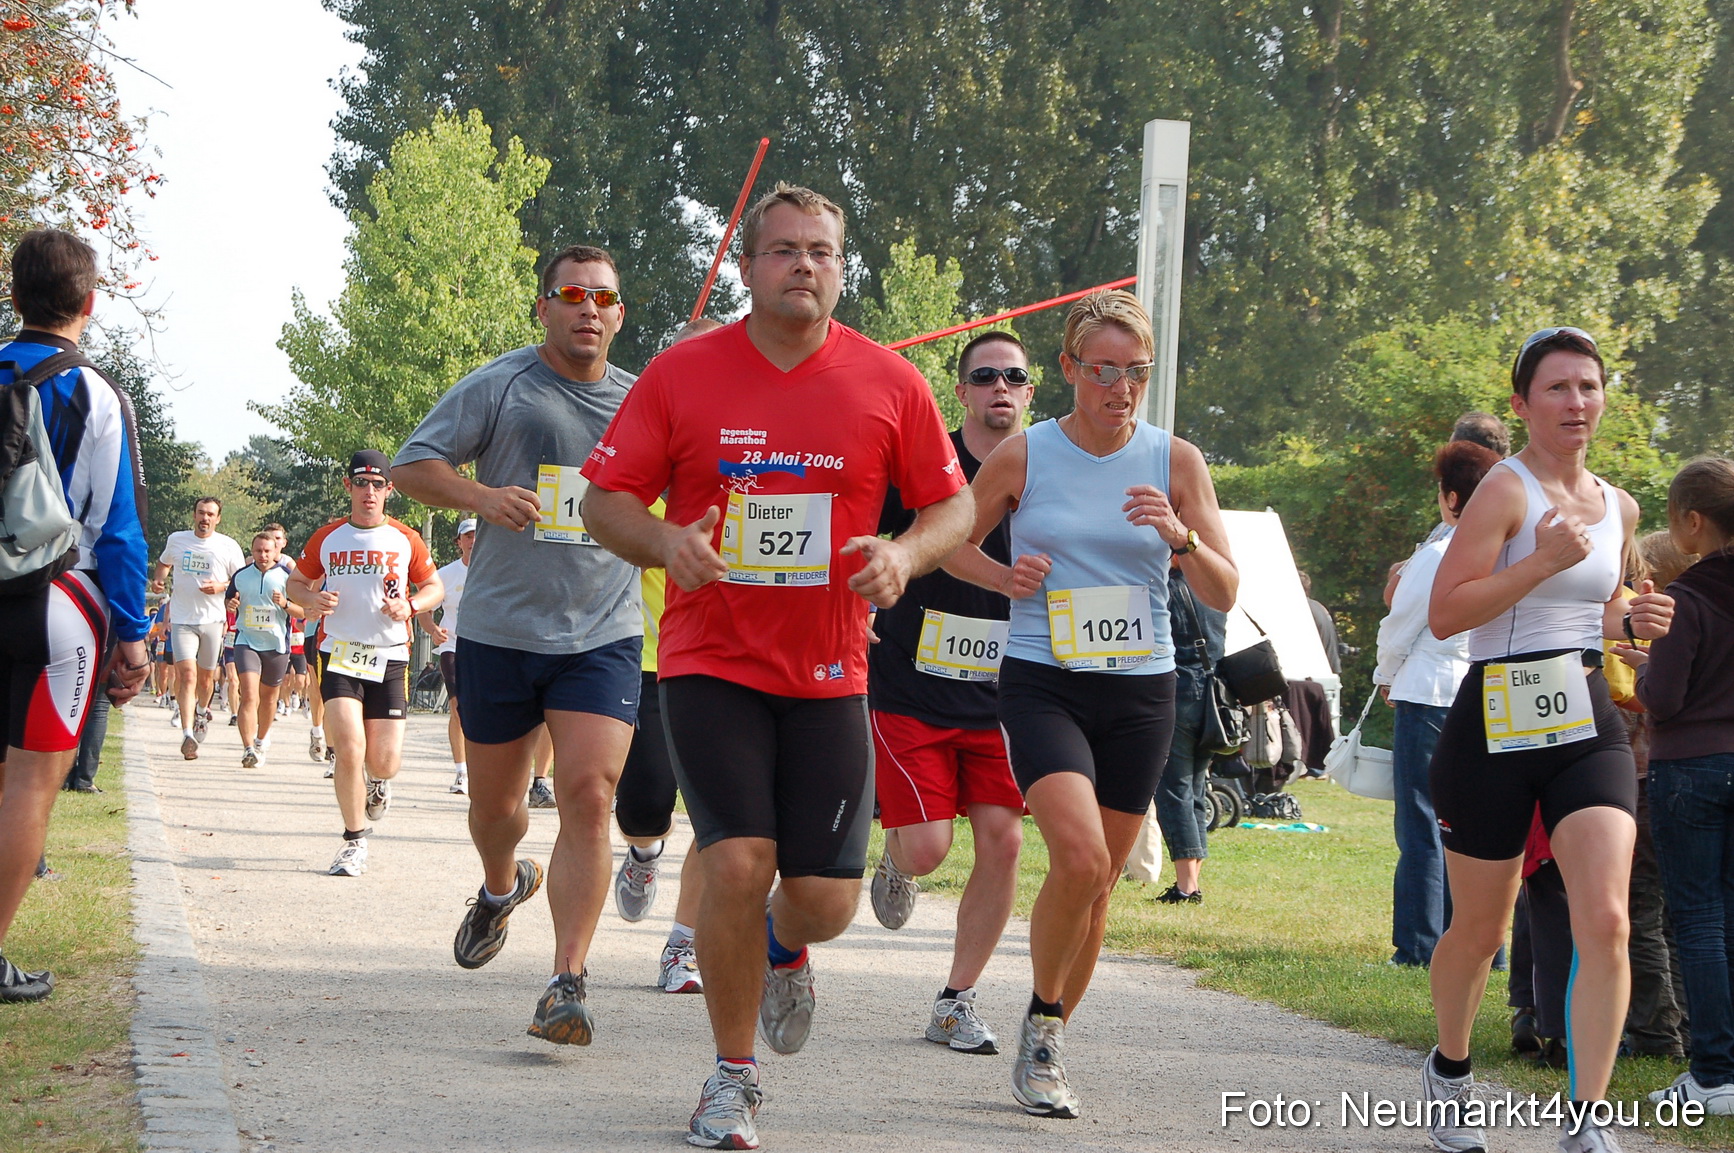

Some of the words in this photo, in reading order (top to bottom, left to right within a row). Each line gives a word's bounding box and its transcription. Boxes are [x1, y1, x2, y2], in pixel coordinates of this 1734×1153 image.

[720, 428, 767, 438] Regensburg
[720, 436, 767, 445] Marathon
[740, 451, 766, 465] 28.
[768, 452, 801, 466] Mai
[802, 453, 845, 470] 2006
[564, 496, 584, 518] 1
[748, 502, 794, 520] Dieter
[758, 530, 813, 556] 527
[191, 560, 211, 570] 3733
[329, 550, 400, 567] MERZ
[329, 561, 384, 577] Reisen
[787, 570, 828, 581] PFLEIDERER
[255, 615, 270, 623] 114
[1082, 617, 1143, 643] 1021
[946, 635, 999, 660] 1008
[351, 651, 378, 668] 514
[70, 646, 87, 718] Giordana
[1511, 669, 1541, 687] Elke
[1488, 698, 1496, 711] C
[1535, 691, 1568, 718] 90
[832, 799, 847, 832] ICEPEAK
